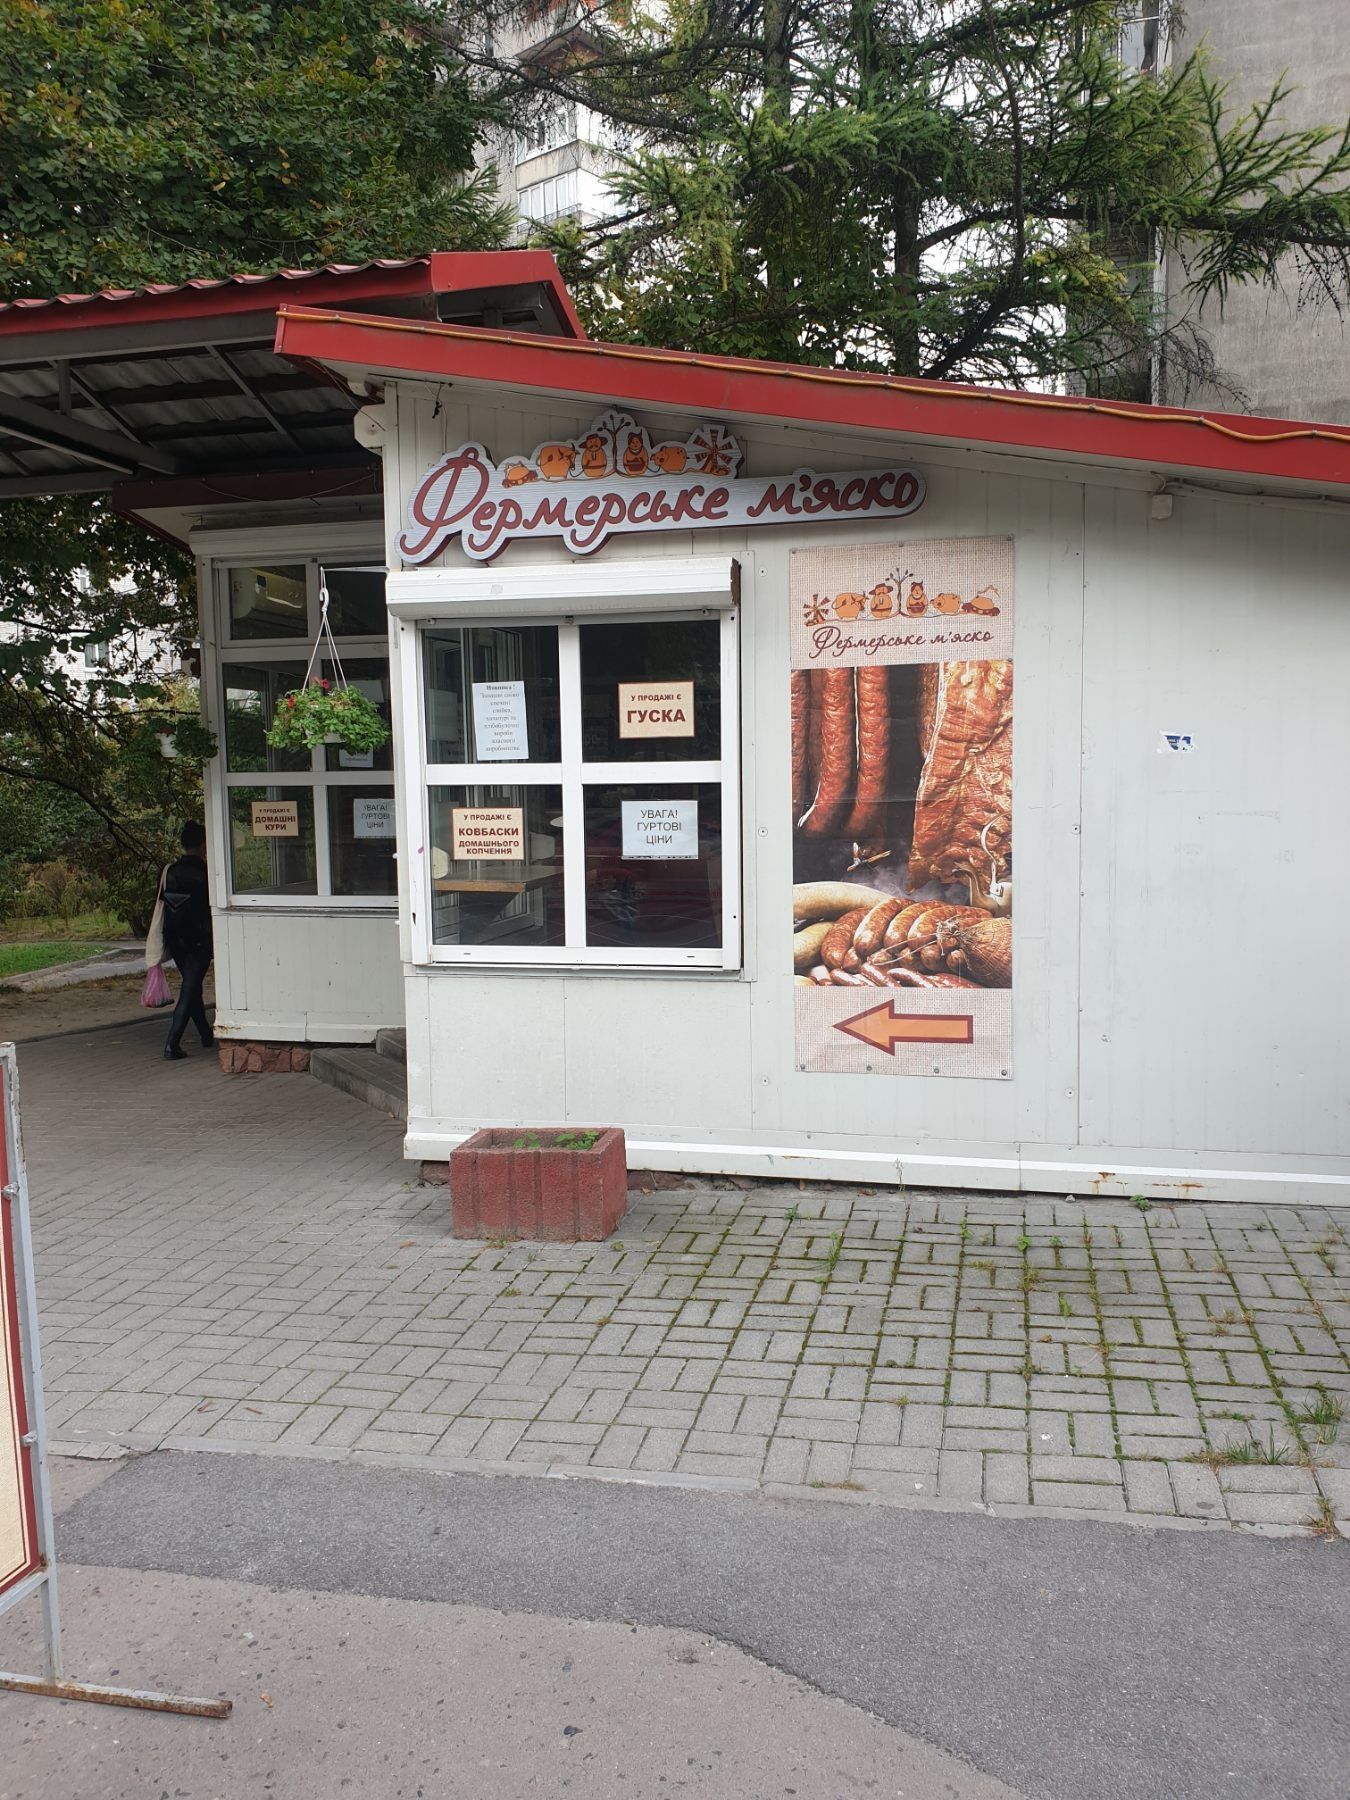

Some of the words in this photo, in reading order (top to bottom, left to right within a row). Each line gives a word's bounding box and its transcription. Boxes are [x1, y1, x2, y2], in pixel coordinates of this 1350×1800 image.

[400, 447, 729, 555] Фермерське
[808, 625, 926, 659] Фермерське
[638, 694, 674, 702] ПРОДАЖІ
[627, 709, 686, 723] ГУСКА
[640, 809, 679, 819] УВАГА!
[255, 815, 296, 824] ДОМАШНІ
[366, 821, 384, 830] ЦІНИ
[636, 822, 682, 831] ГУРТОВІ
[458, 827, 519, 836] КОВБАСКИ
[458, 840, 520, 848] ДОМАШНЬОГО
[645, 835, 673, 846] ЦІНИ
